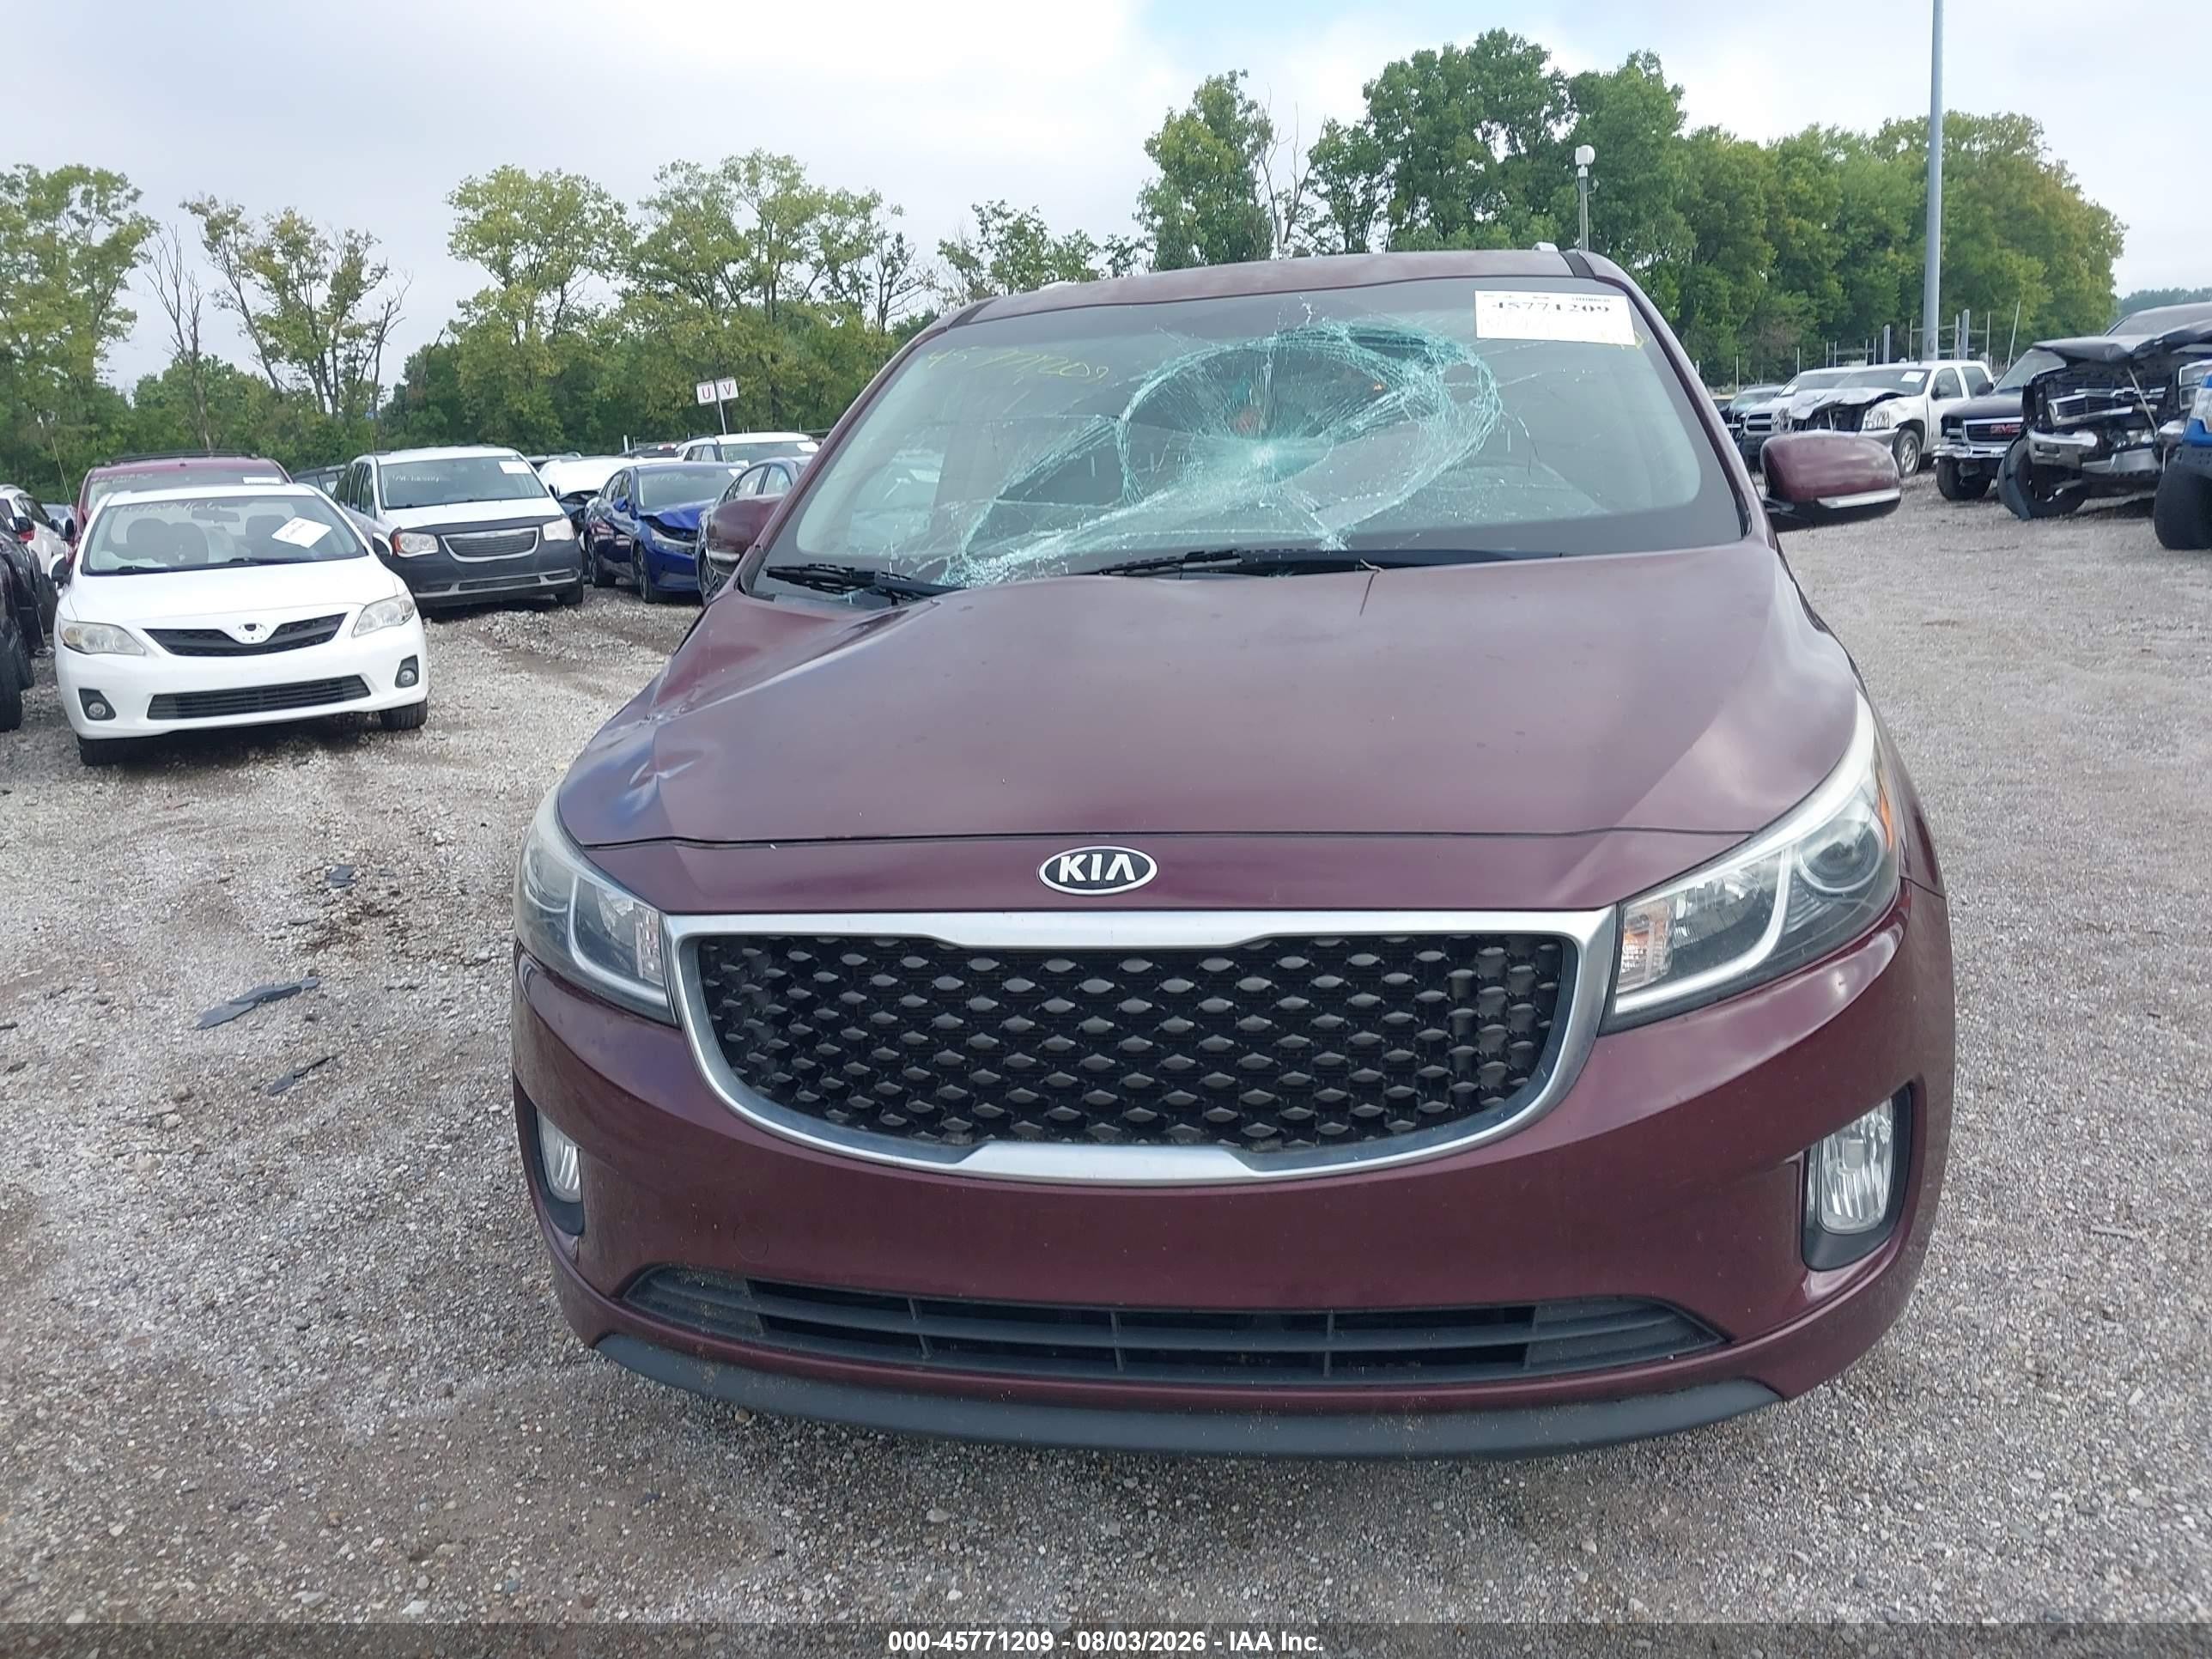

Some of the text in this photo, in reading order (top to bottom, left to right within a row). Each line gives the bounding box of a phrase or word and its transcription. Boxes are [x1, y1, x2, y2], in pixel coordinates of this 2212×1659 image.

[702, 383, 732, 400] U V
[1059, 854, 1136, 883] KIA
